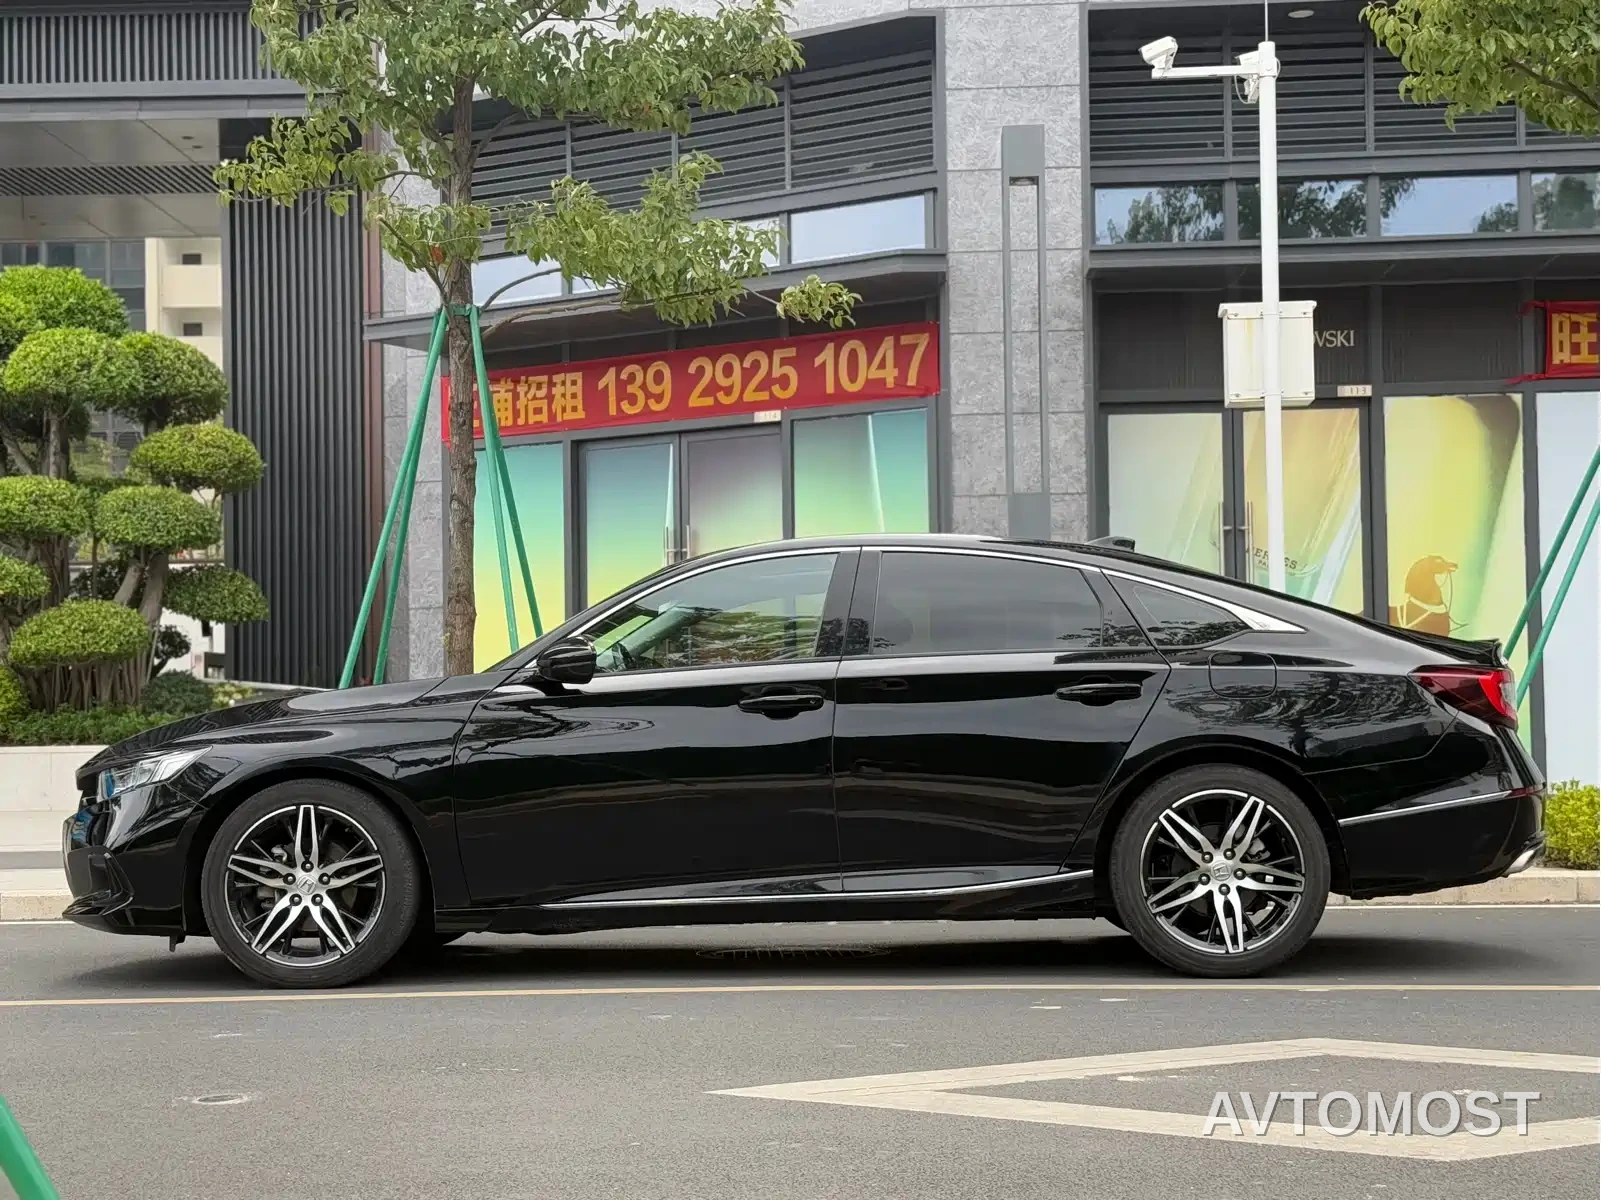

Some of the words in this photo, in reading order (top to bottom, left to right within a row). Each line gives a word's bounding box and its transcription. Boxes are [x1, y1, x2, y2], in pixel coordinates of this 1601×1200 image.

[1314, 329, 1355, 348] VSKI
[449, 371, 586, 427] 铺招租
[598, 361, 672, 416] 139
[687, 346, 798, 408] 2925
[814, 332, 930, 394] 1047
